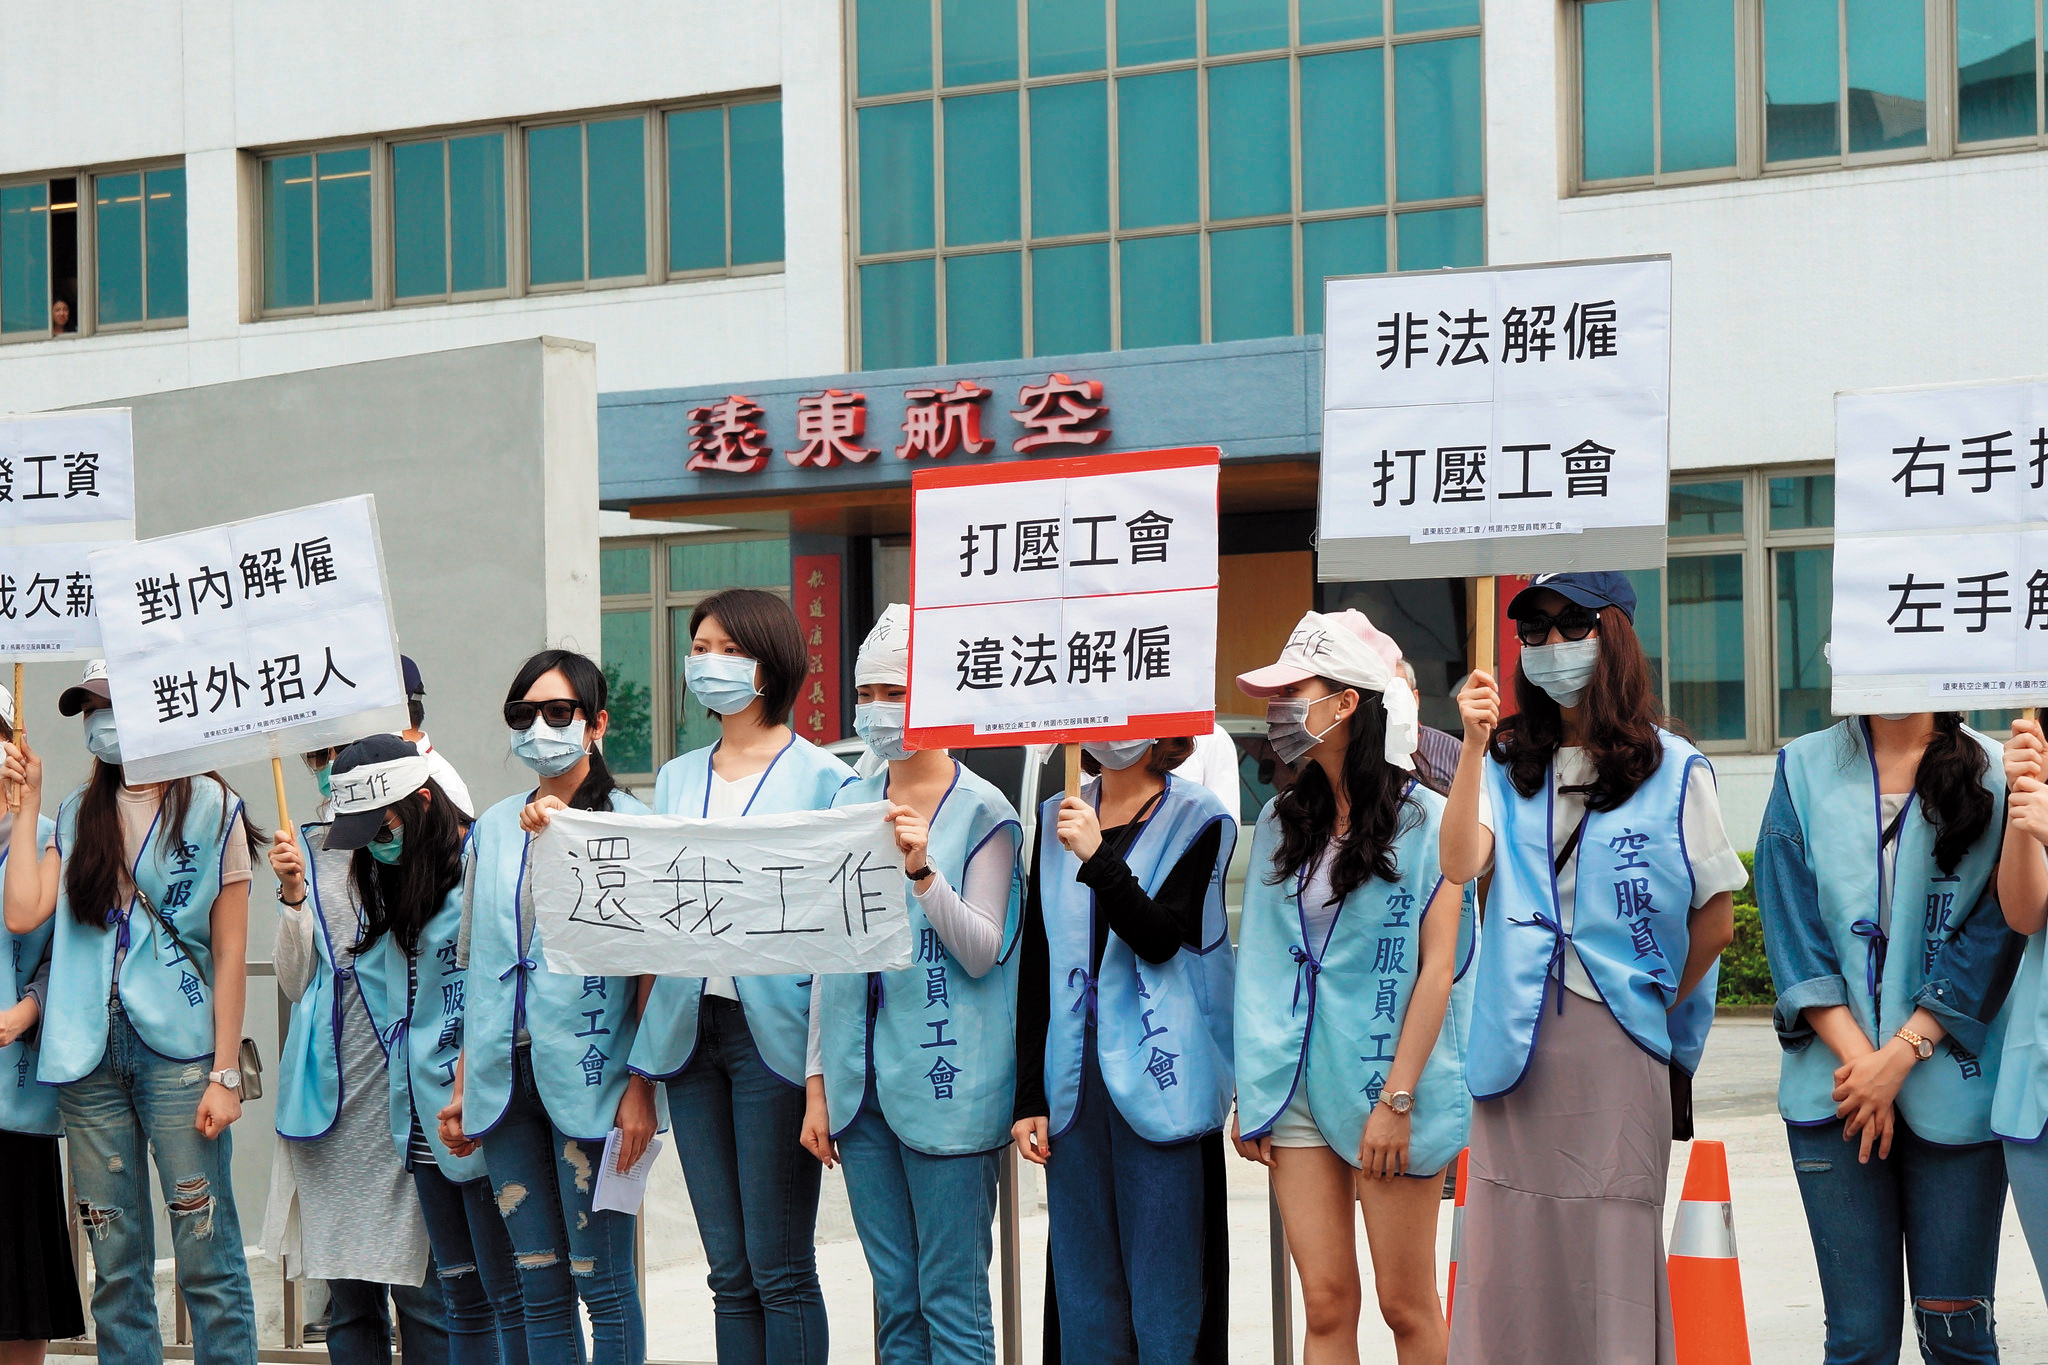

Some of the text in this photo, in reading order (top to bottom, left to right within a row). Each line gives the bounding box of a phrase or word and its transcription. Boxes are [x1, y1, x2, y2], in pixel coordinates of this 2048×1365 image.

[1376, 299, 1618, 371] 非法解僱
[685, 373, 1112, 473] 遠東航空
[1372, 439, 1616, 507] 打壓工會
[135, 536, 338, 625] 對內解僱
[959, 509, 1174, 578] 打壓工會
[152, 646, 357, 725] 對外招人
[956, 624, 1171, 692] 違法解僱
[160, 840, 204, 1008] 空服員工會
[568, 836, 898, 937] 還我工作
[916, 914, 964, 1101] 服員工會
[1137, 972, 1180, 1092] 工會
